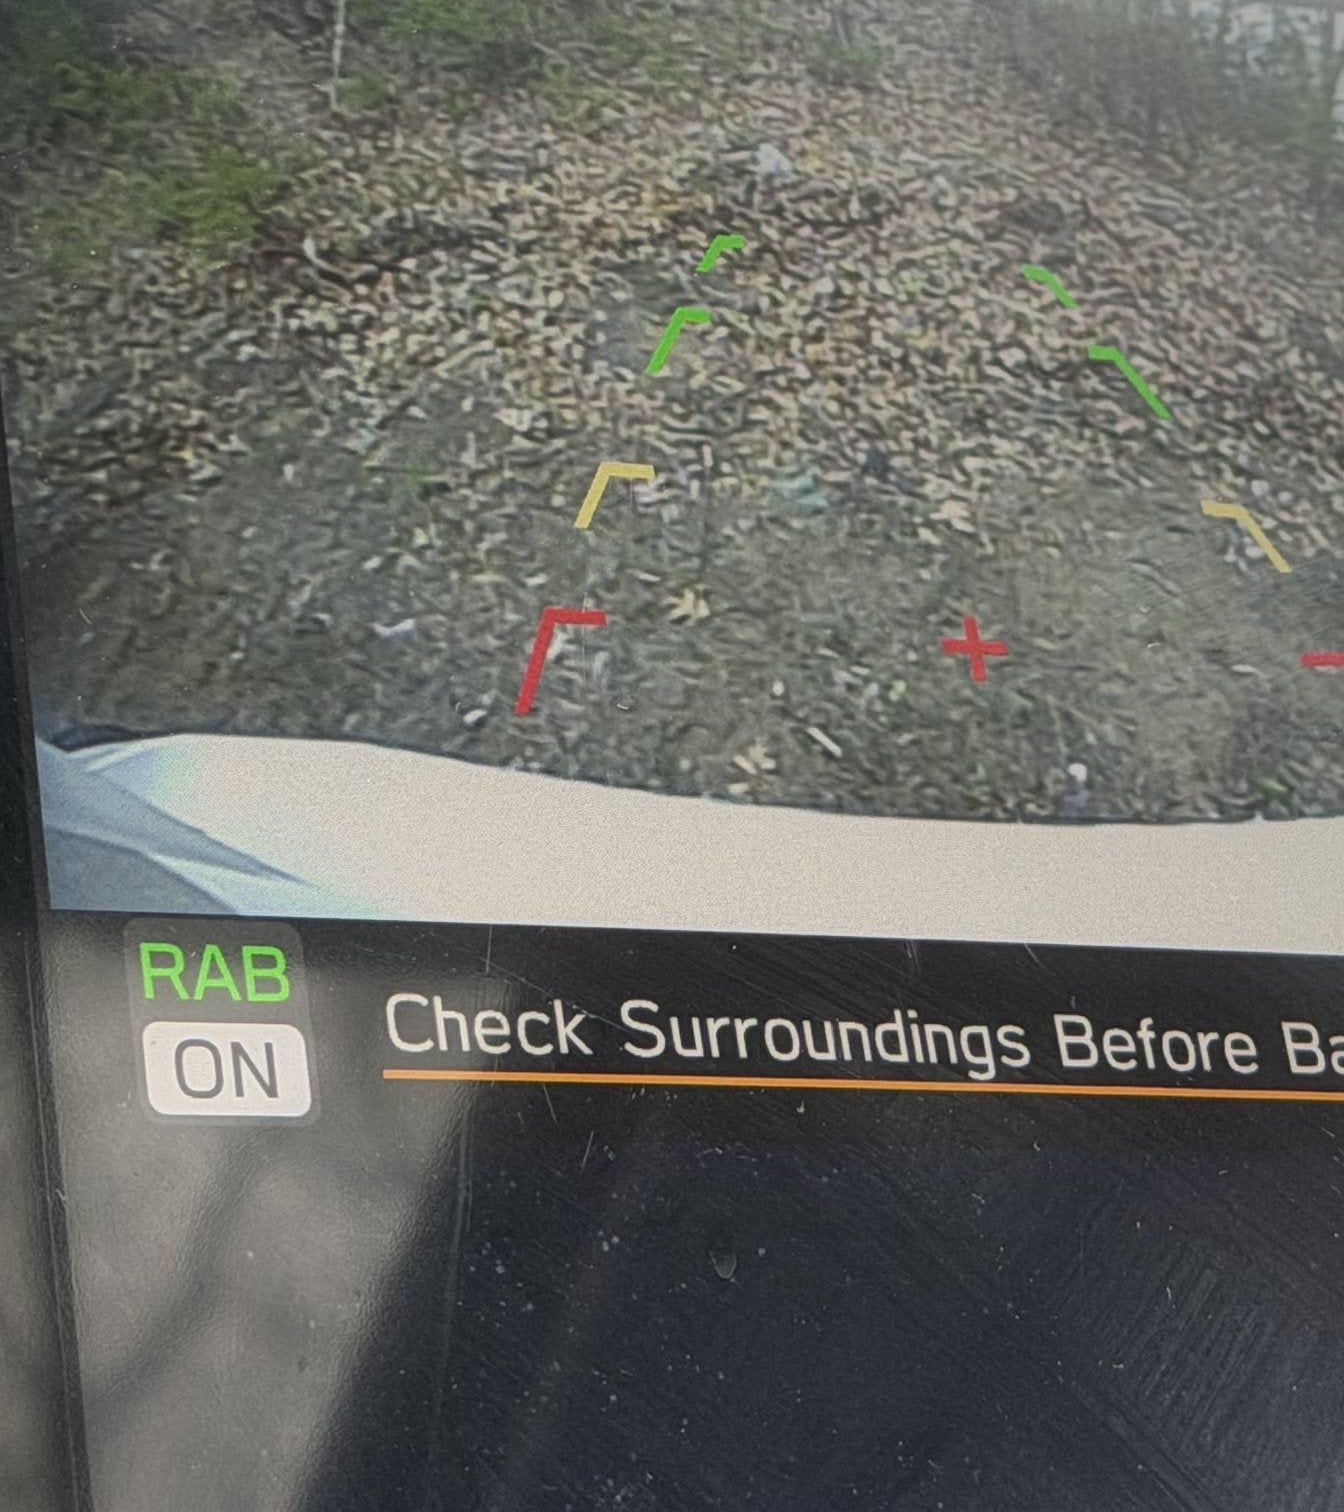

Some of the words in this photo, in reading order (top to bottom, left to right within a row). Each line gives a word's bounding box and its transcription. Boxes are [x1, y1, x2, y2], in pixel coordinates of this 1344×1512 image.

[139, 941, 291, 1004] RAB
[384, 992, 594, 1058] Check
[620, 999, 1032, 1080] Surroundings
[1054, 1014, 1258, 1075] Before
[173, 1038, 281, 1100] ON
